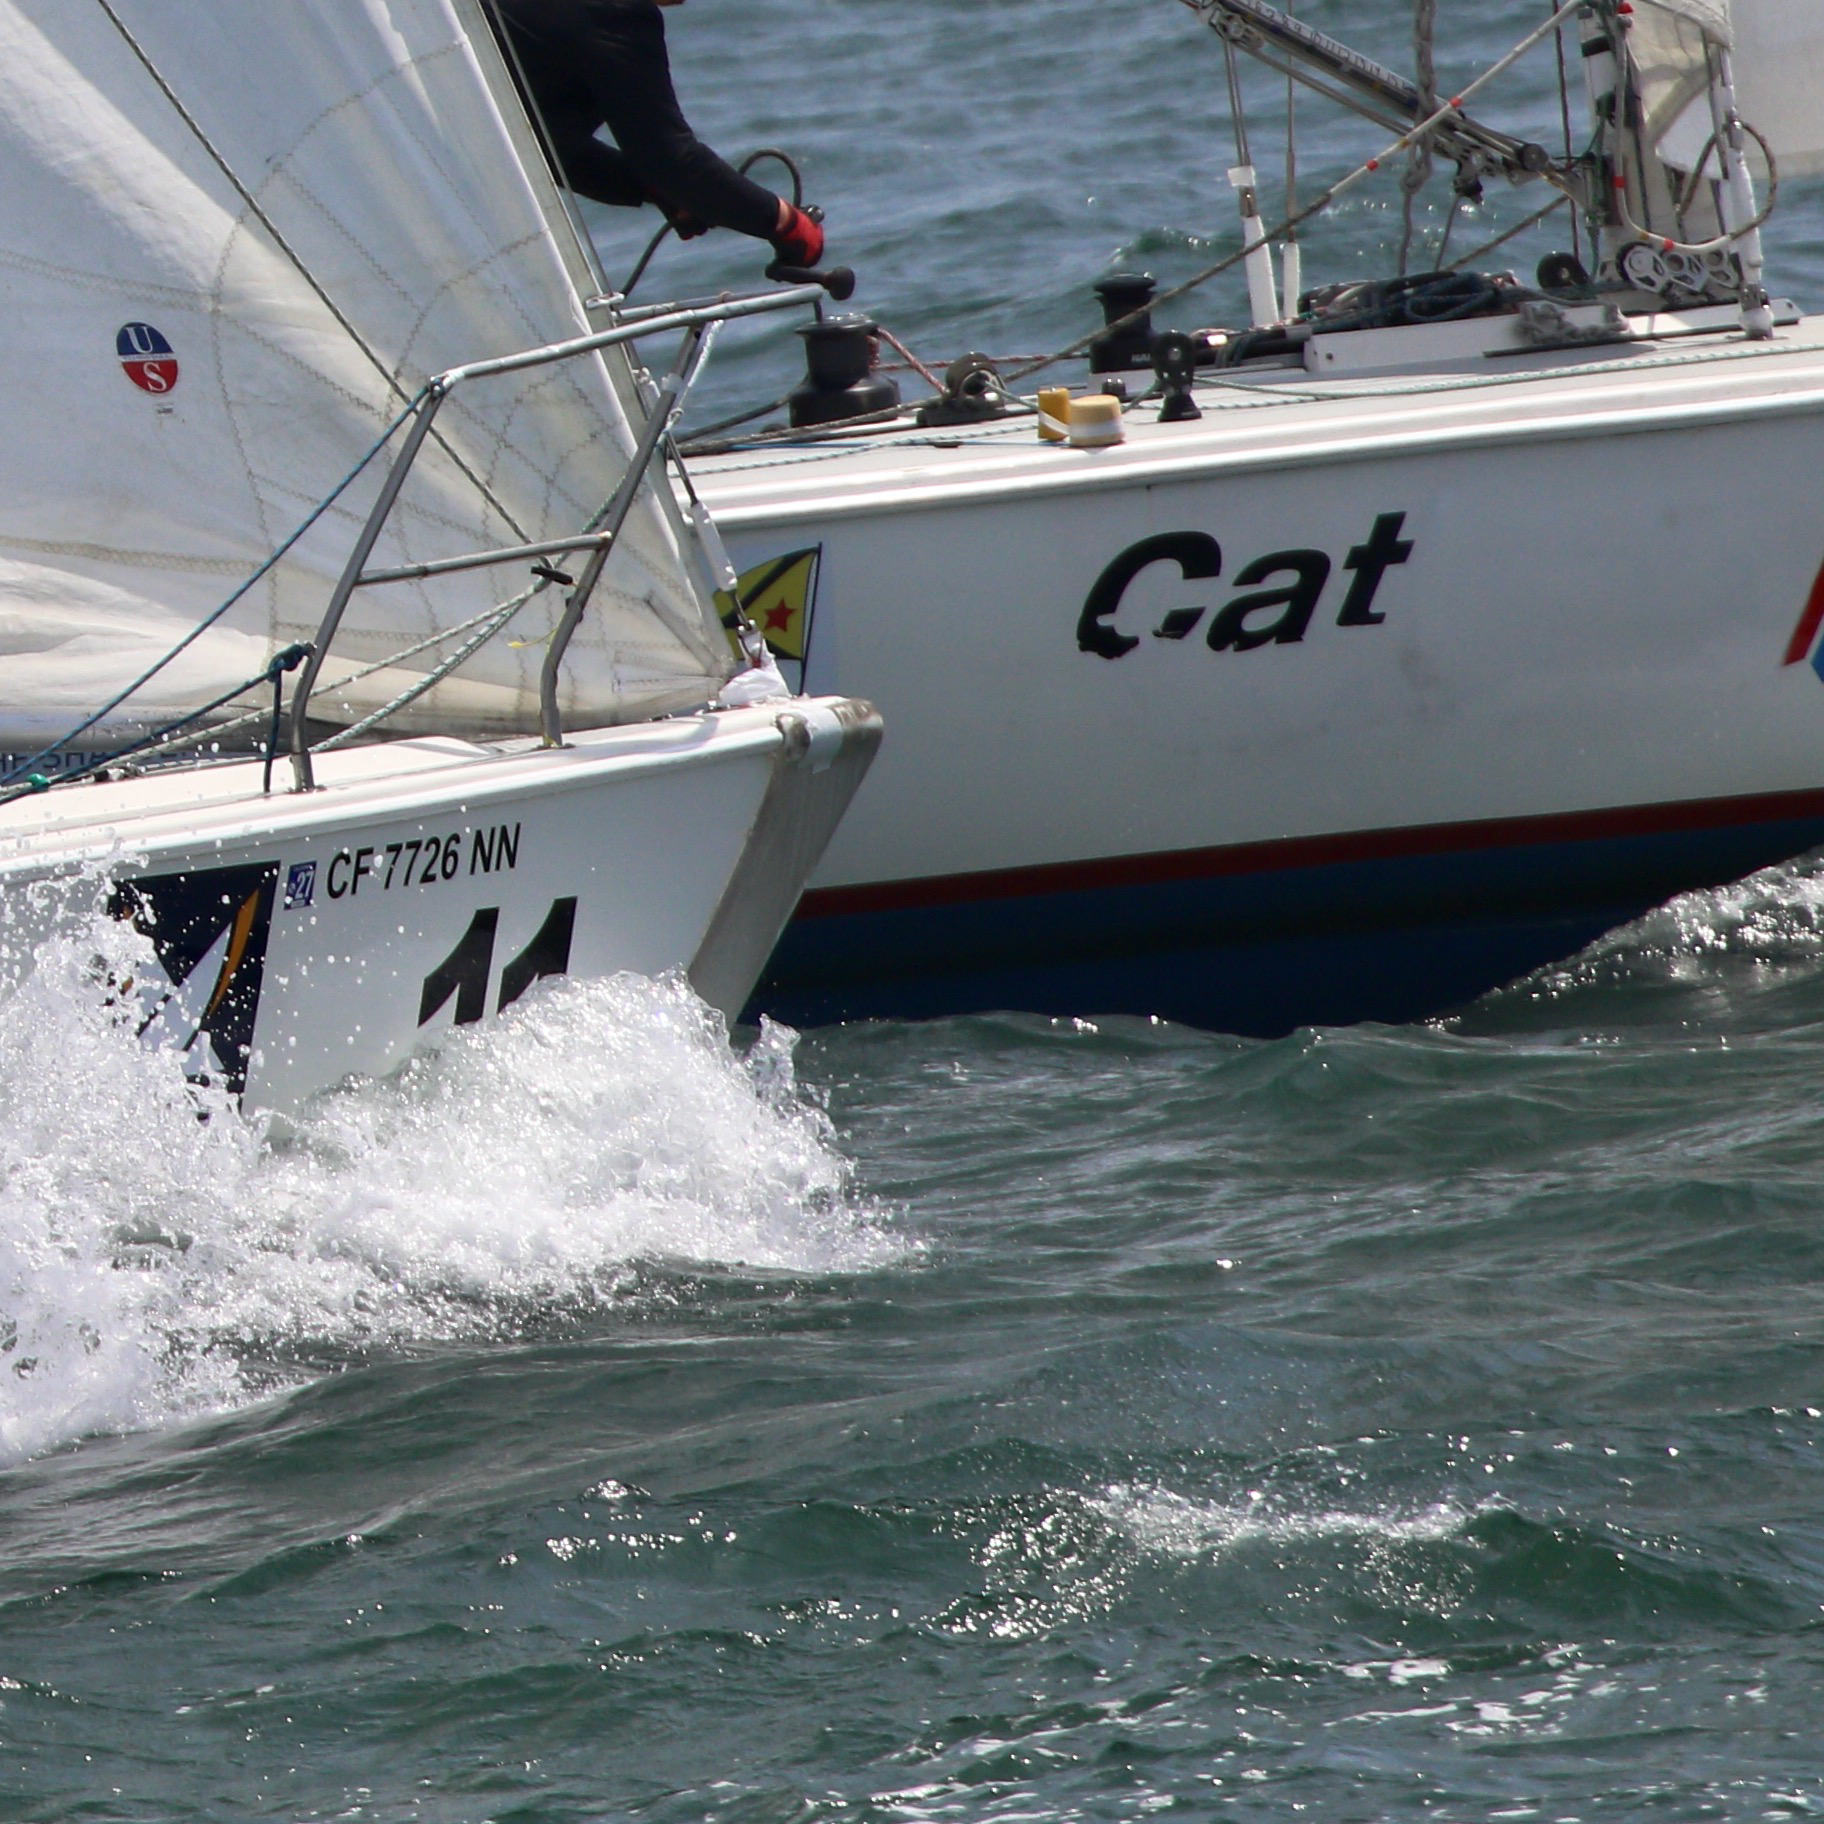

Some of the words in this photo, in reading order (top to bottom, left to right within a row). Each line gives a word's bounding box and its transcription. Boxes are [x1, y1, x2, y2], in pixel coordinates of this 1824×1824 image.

[1077, 511, 1415, 659] Cat
[327, 847, 374, 899] CF
[384, 833, 460, 890] 7726
[470, 823, 520, 875] NN
